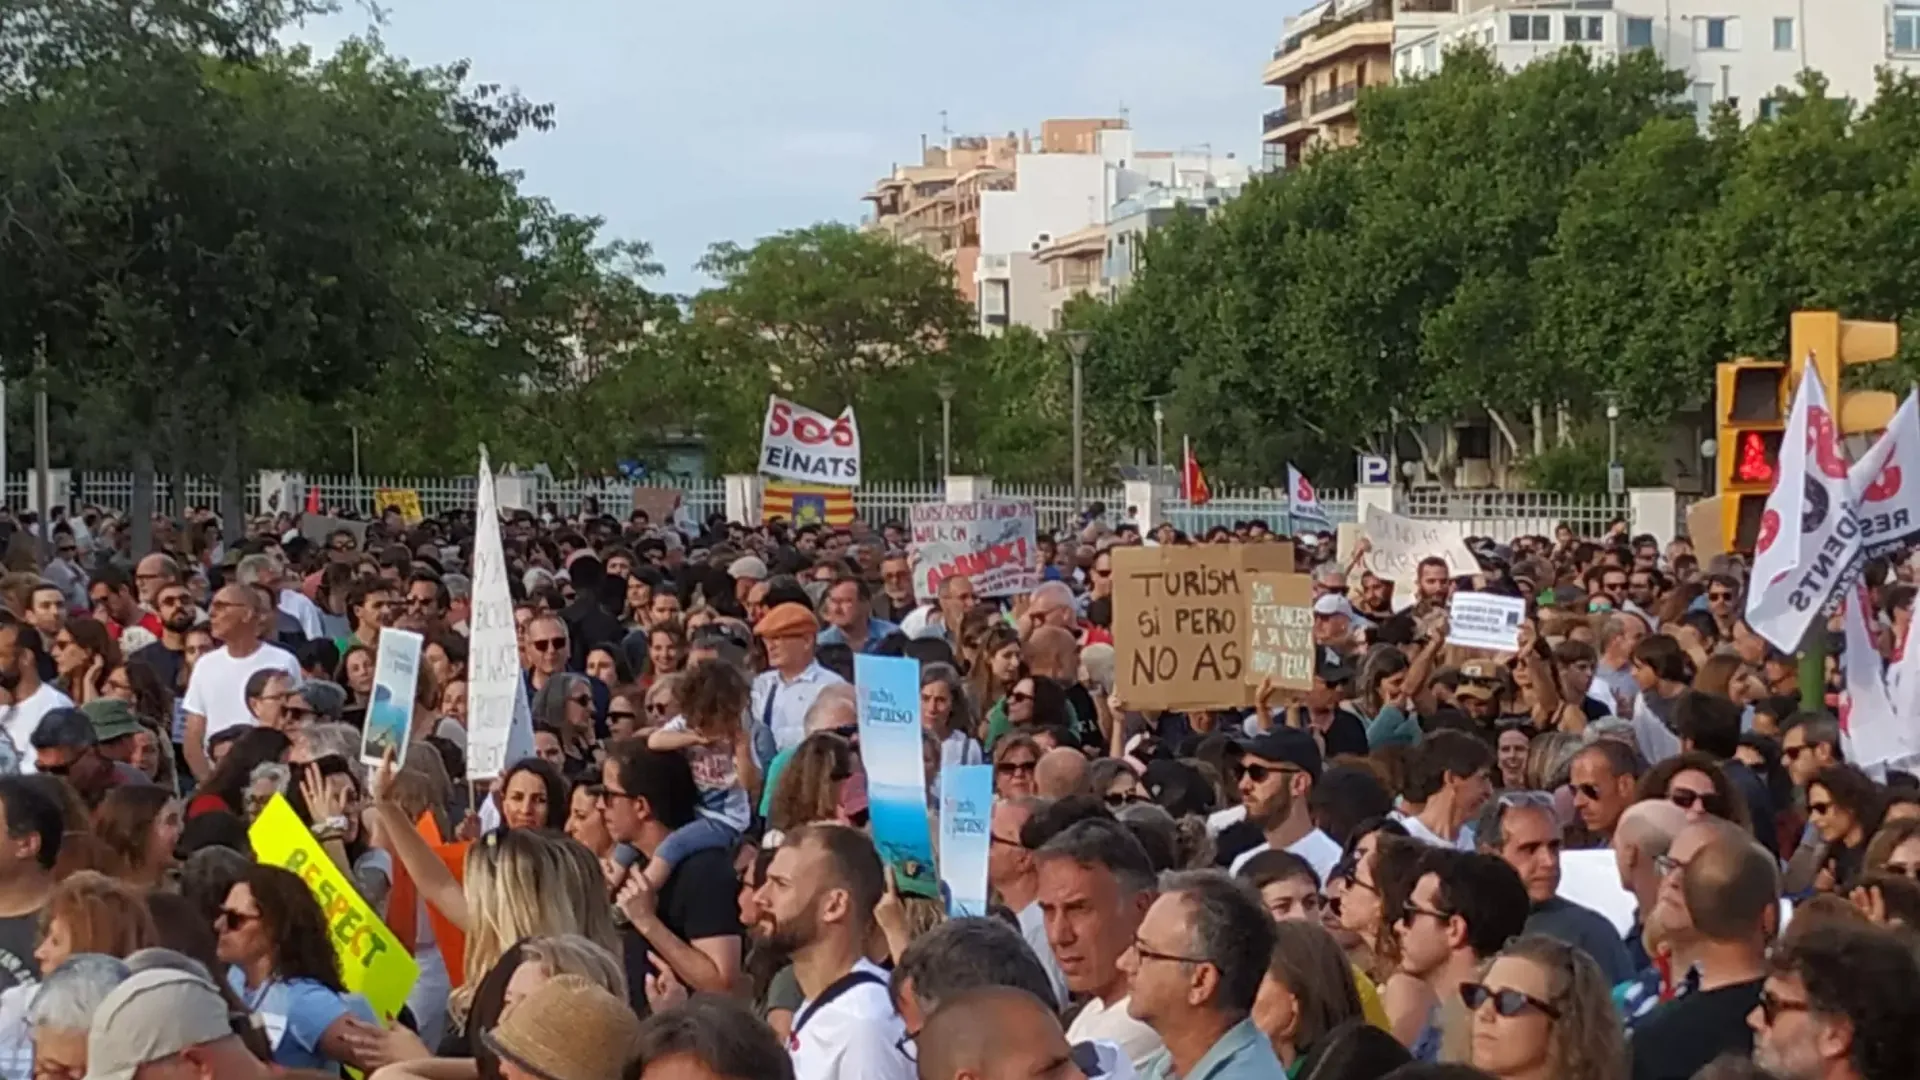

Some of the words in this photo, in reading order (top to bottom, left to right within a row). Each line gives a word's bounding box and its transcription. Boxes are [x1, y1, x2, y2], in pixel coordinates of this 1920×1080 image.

[769, 402, 854, 447] SOS
[765, 444, 857, 477] EÏNATS
[1362, 456, 1388, 485] P
[1130, 564, 1258, 598] TURISM
[1175, 608, 1236, 635] PERO
[1131, 646, 1179, 686] NO
